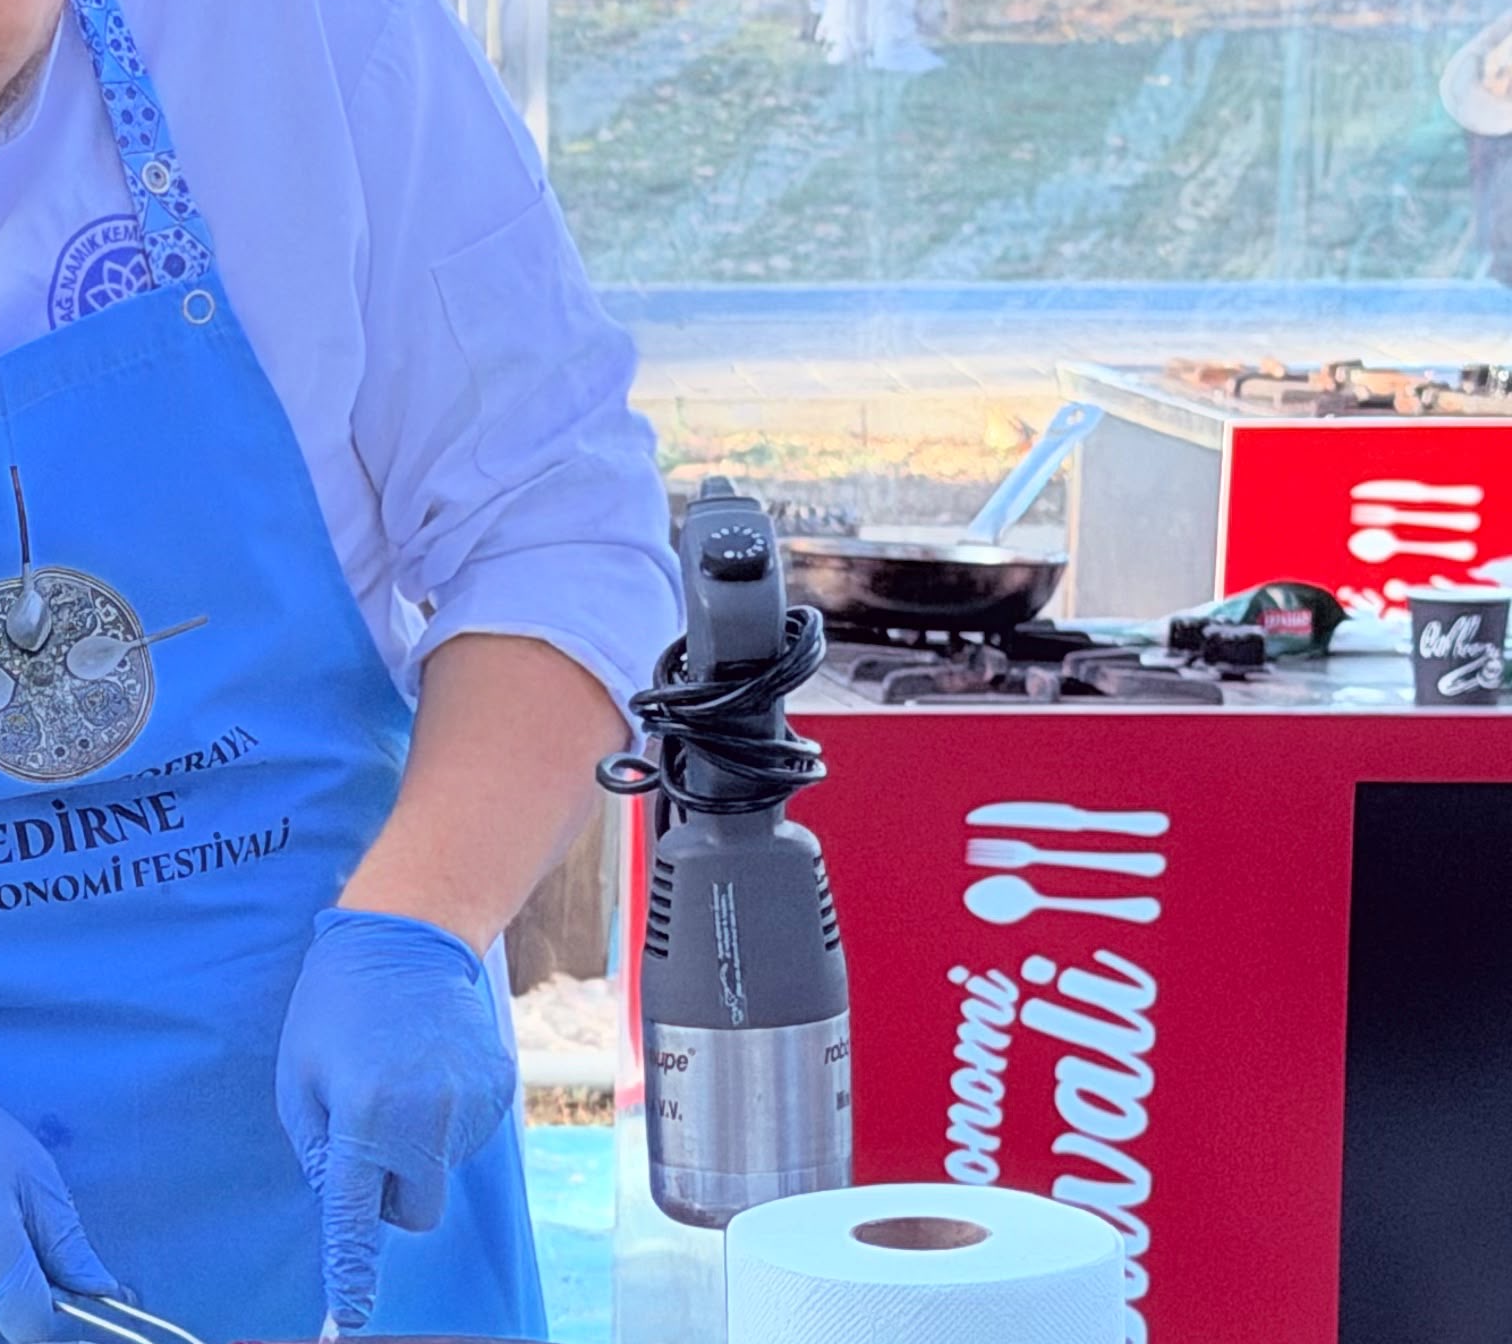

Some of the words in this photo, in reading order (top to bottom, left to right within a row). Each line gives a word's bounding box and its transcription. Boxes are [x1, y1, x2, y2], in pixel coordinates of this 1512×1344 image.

[60, 233, 104, 290] NAMIK
[101, 224, 142, 246] KEM
[132, 816, 291, 889] FESTİVALİ
[944, 965, 1021, 1186] onomi
